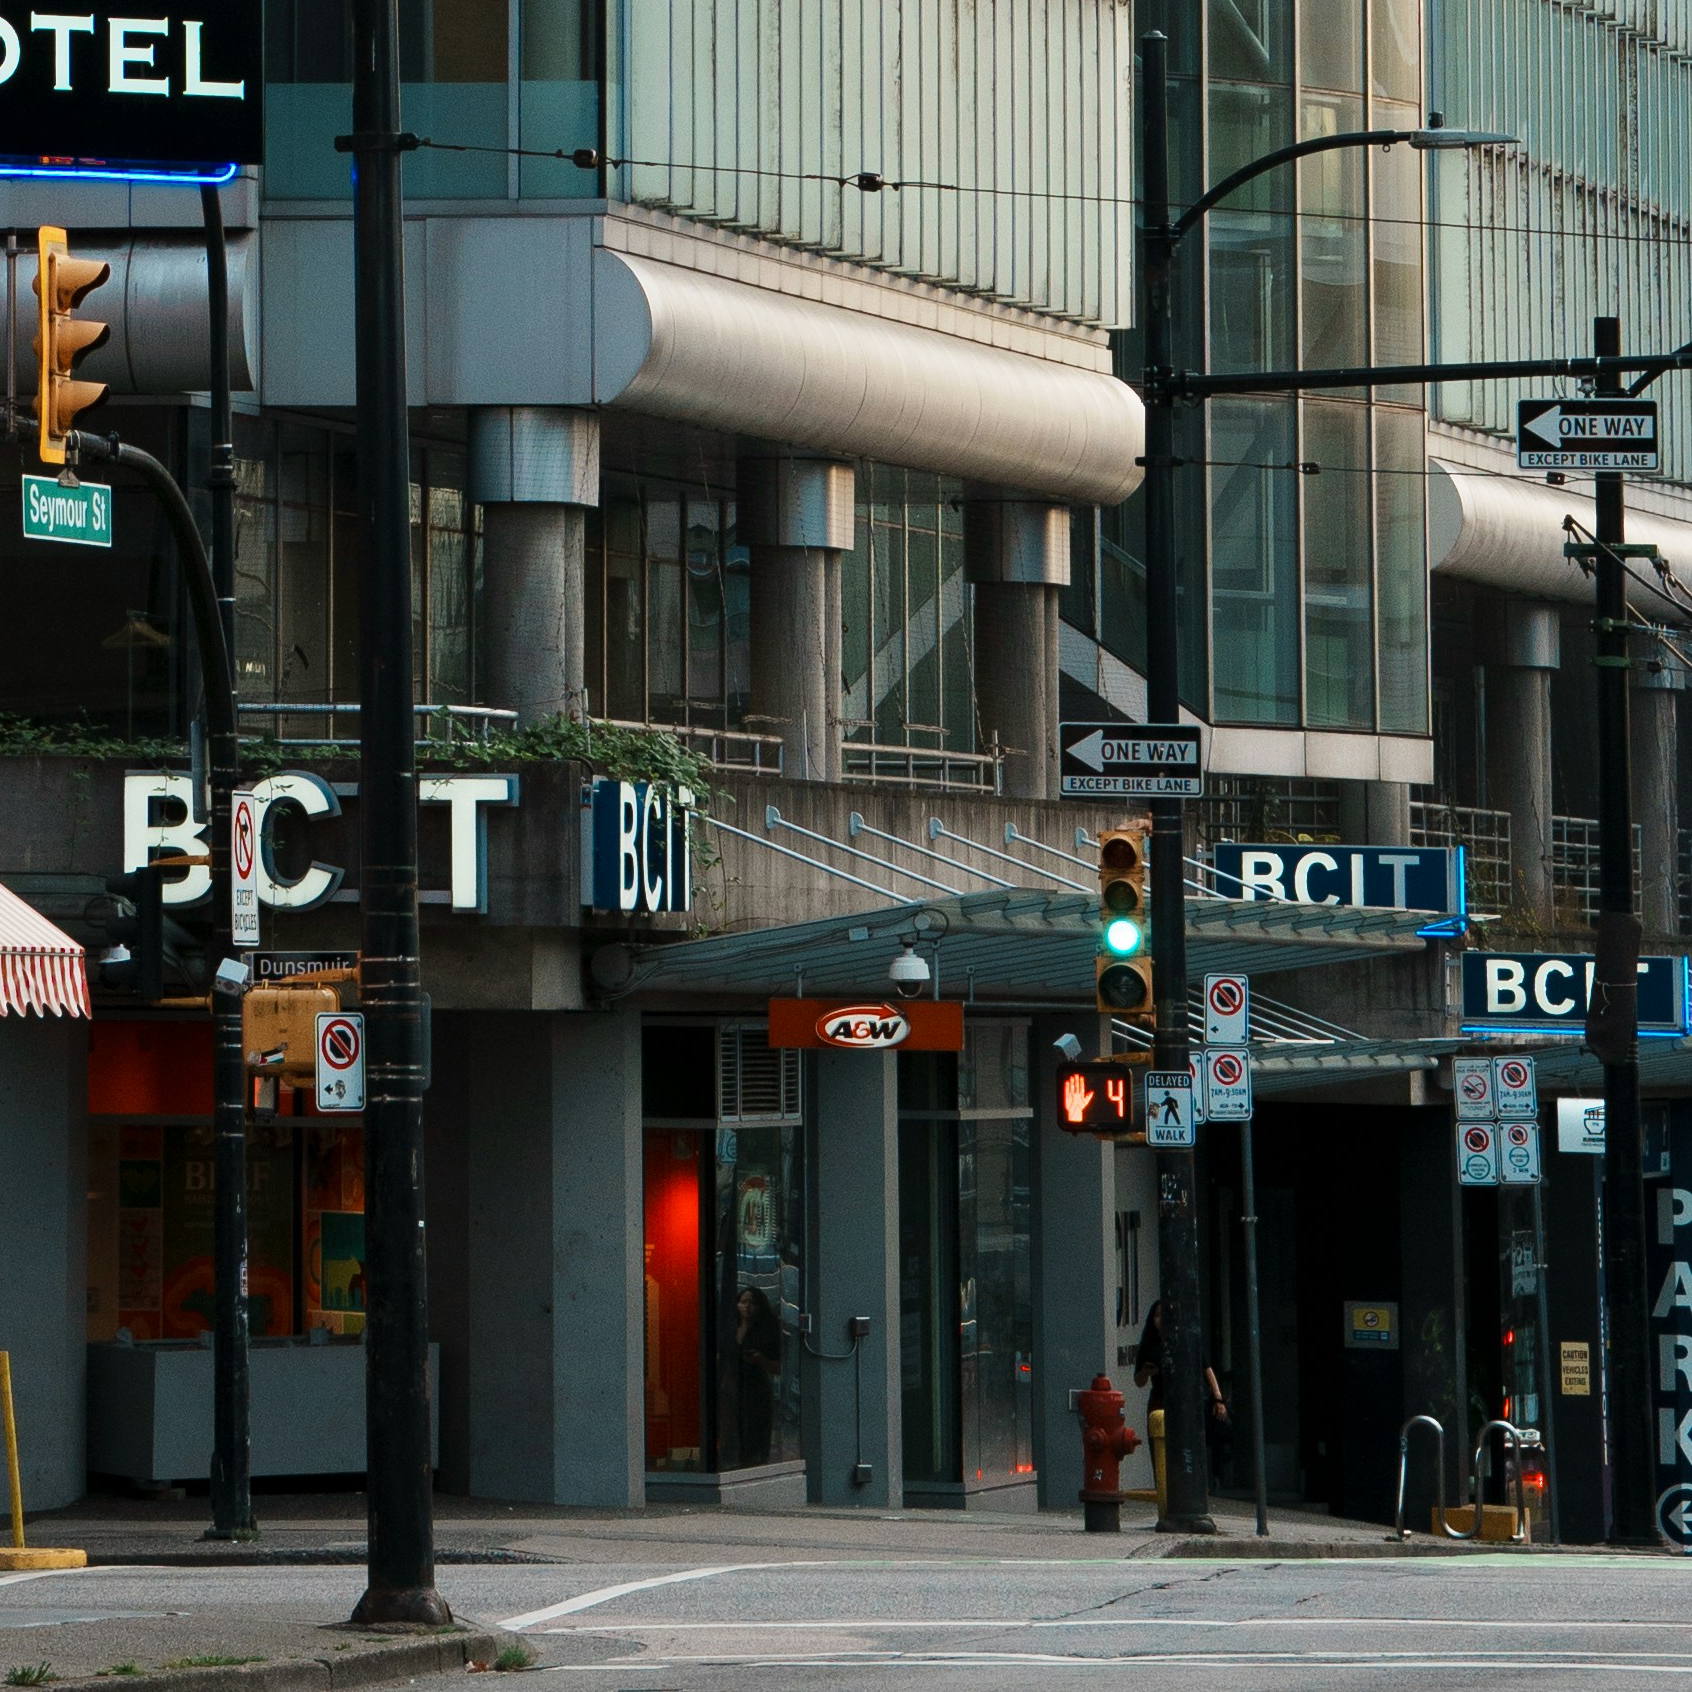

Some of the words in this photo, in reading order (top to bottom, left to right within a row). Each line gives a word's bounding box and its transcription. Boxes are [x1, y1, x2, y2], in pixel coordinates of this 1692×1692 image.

[1559, 417, 1598, 436] ONE
[1604, 417, 1645, 437] WAY
[1528, 453, 1577, 465] EXCEPT
[1579, 454, 1612, 466] BIKE
[1614, 454, 1648, 466] LANE
[29, 483, 87, 533] Seymour
[92, 491, 106, 531] St
[1101, 741, 1141, 760] ONE
[1147, 743, 1189, 762] WAY
[1070, 777, 1119, 790] EXCEPT
[1122, 778, 1152, 791] BIKE
[1157, 780, 1191, 792] LANE
[124, 772, 511, 910] BCT
[1241, 851, 1420, 909] BCIT
[236, 889, 254, 906] EXCEPT
[828, 1020, 902, 1040] A&W
[1148, 1075, 1190, 1088] DELAYED
[1107, 1079, 1124, 1118] 4
[1155, 1129, 1186, 1141] WALK
[1562, 1350, 1588, 1360] CAUTION
[1562, 1366, 1589, 1375] VEHICLES
